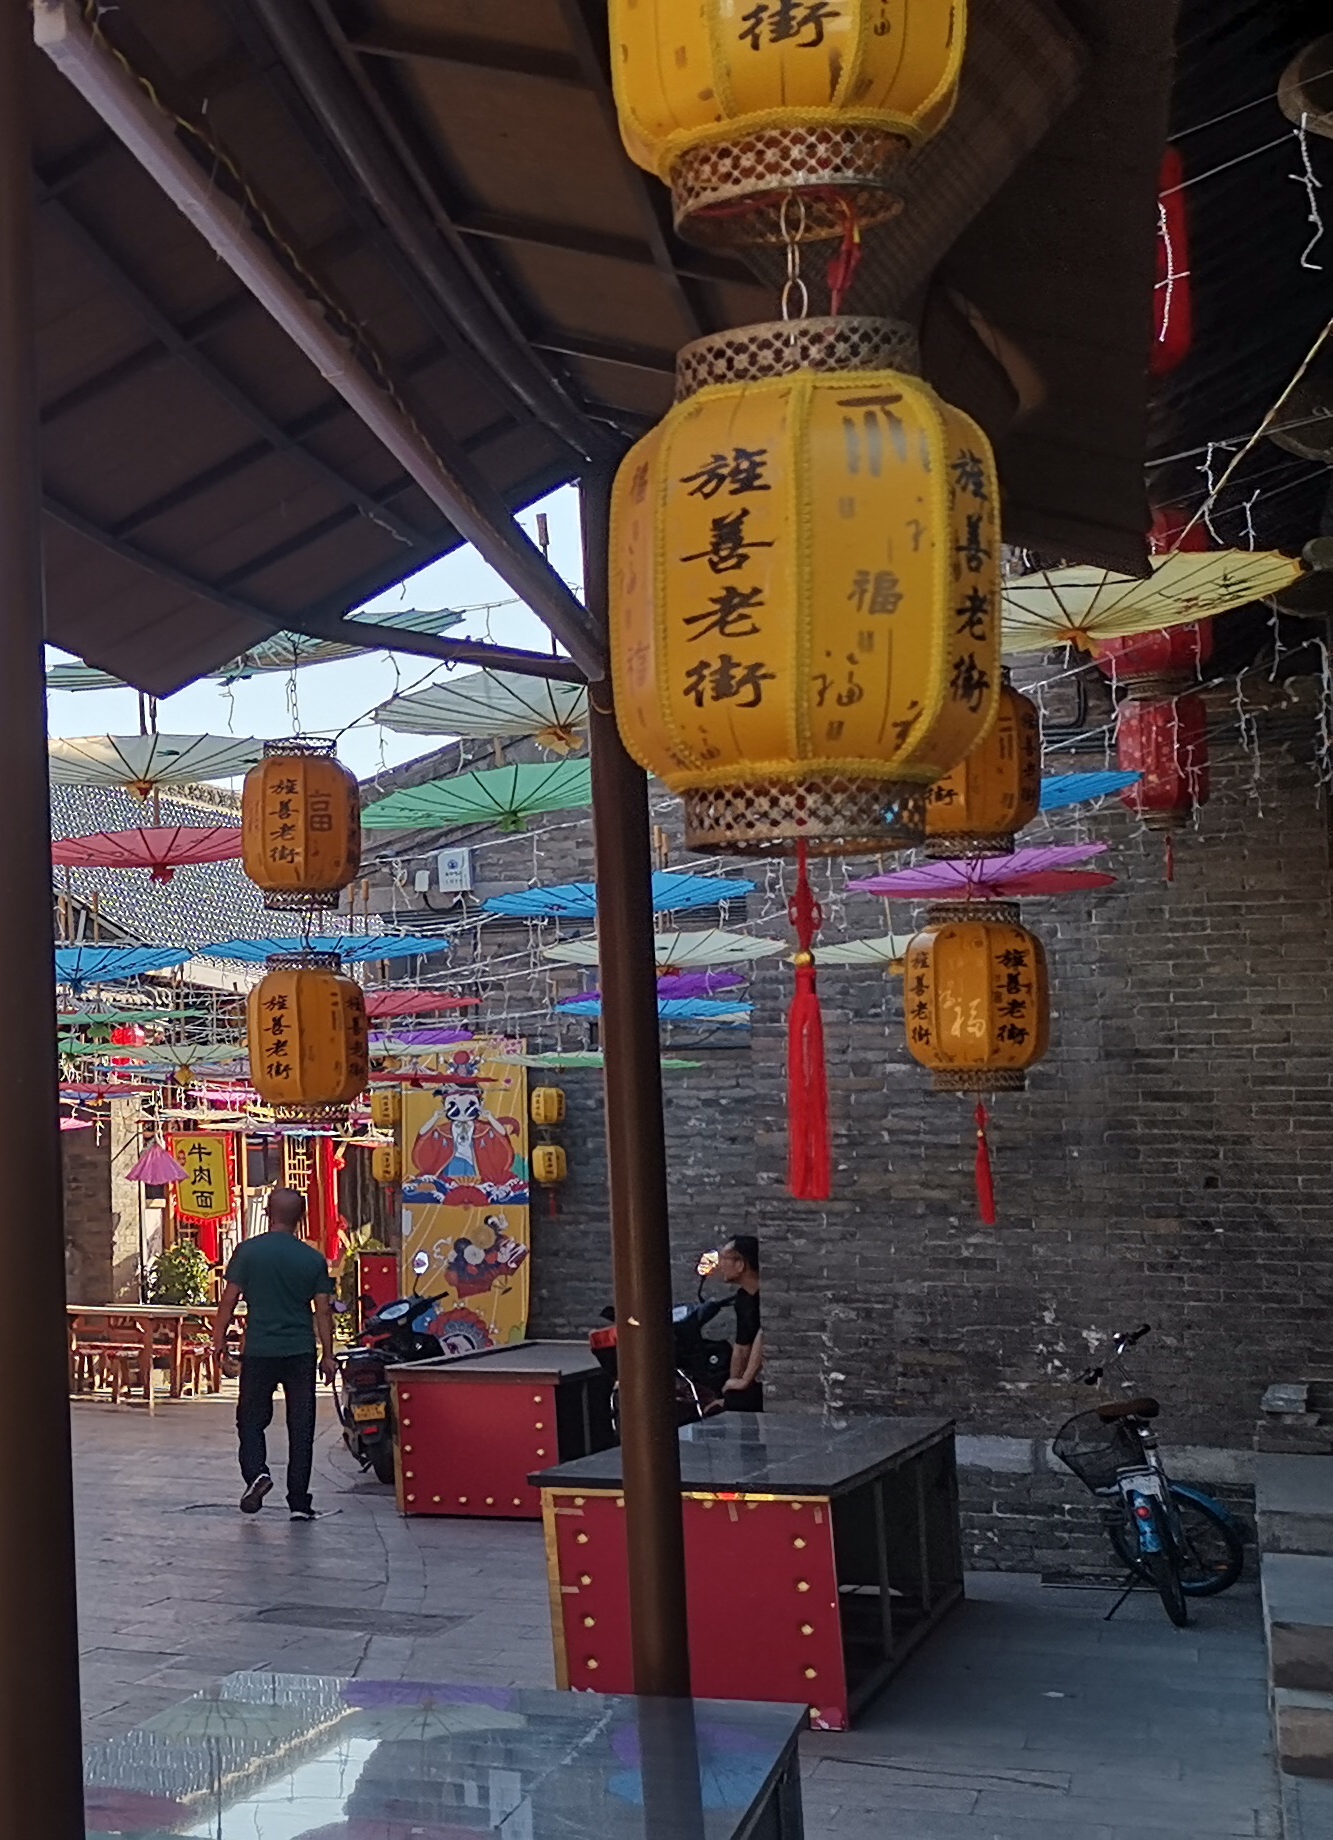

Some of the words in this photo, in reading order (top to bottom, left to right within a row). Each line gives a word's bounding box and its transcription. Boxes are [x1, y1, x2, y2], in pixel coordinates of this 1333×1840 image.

[680, 448, 777, 709] 旌善老街
[949, 449, 992, 712] 旌善老街
[269, 779, 300, 863] 旌善老街
[263, 995, 293, 1080] 旌善老街
[188, 1142, 214, 1209] 牛肉面
